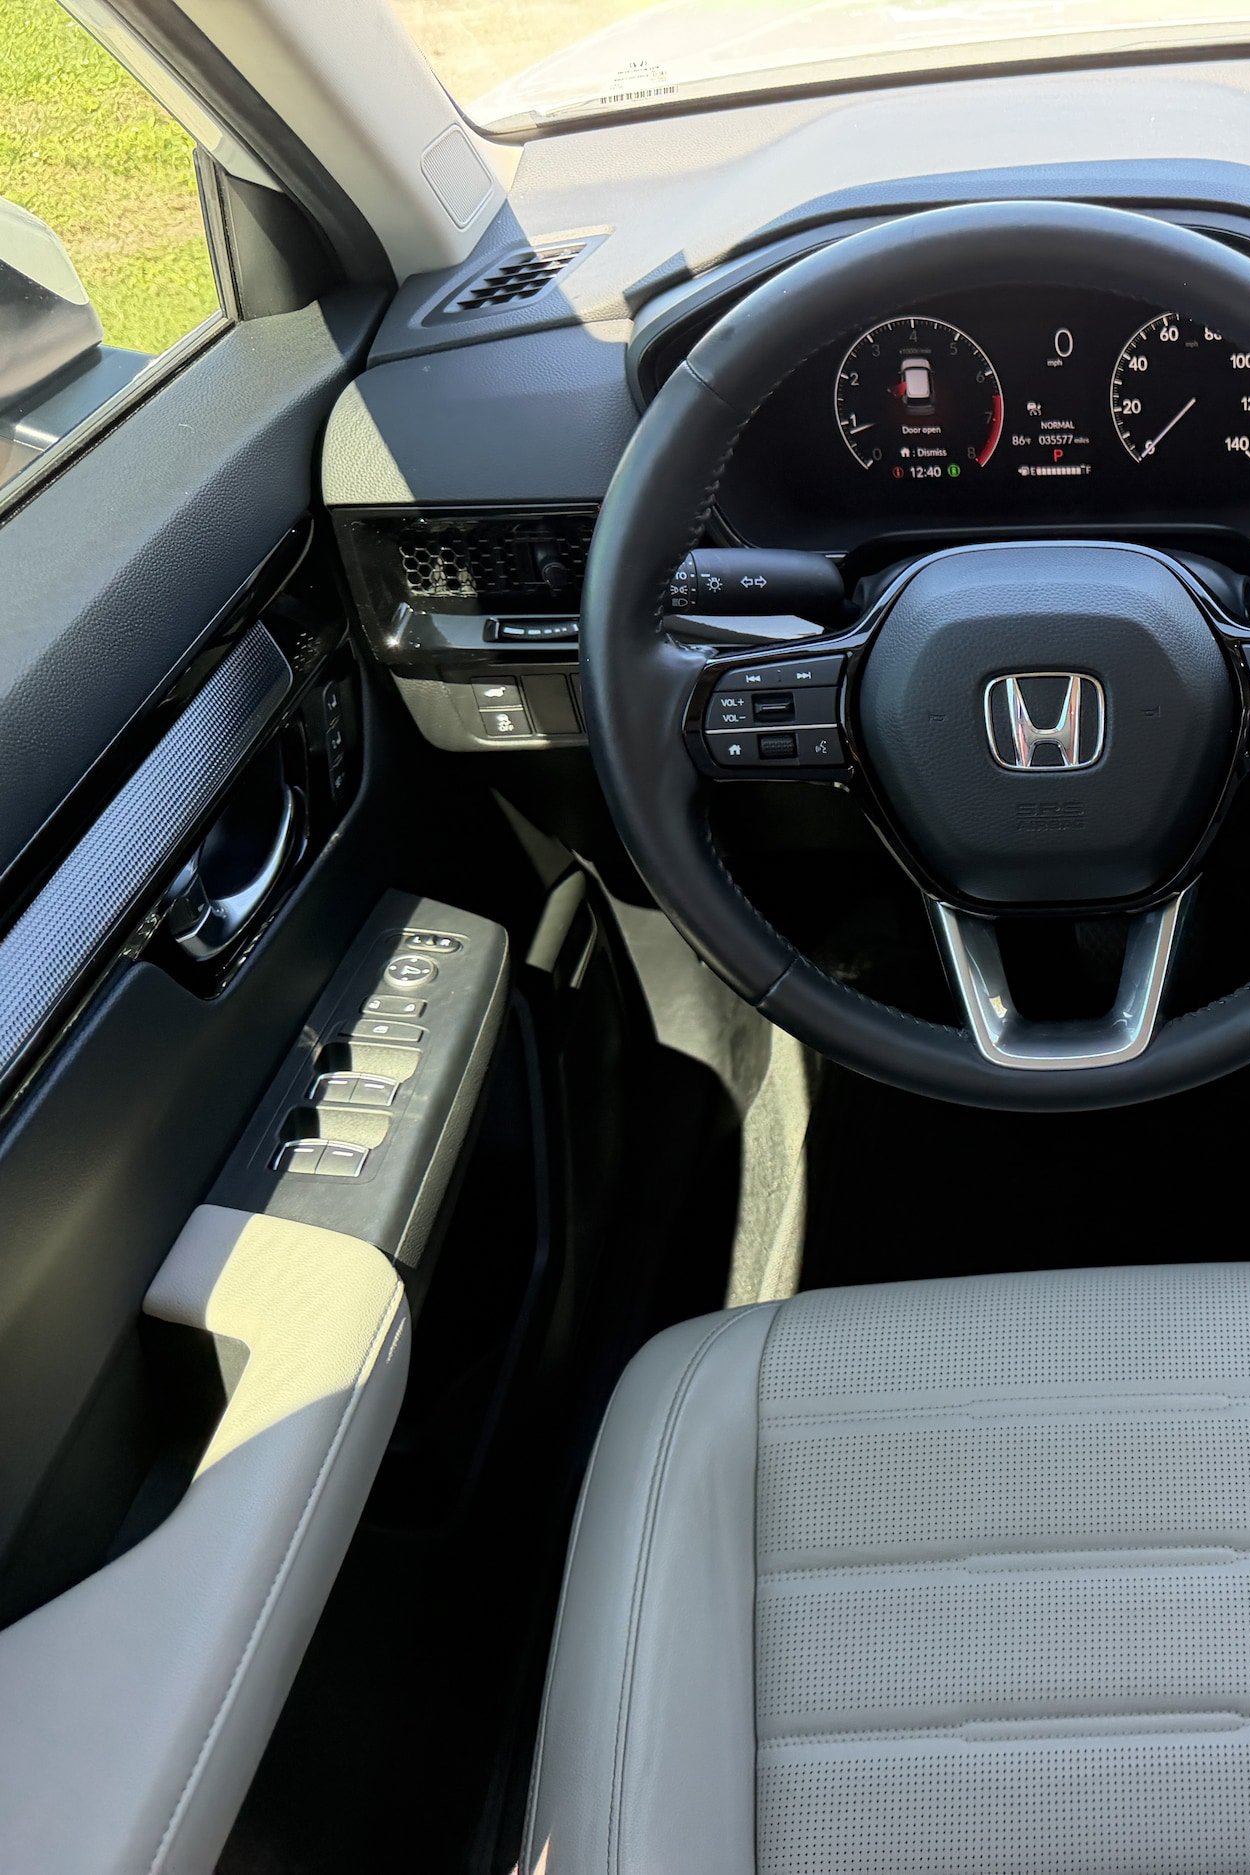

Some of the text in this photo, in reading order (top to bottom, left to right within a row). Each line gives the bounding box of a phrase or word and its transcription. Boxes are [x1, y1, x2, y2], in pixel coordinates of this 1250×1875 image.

[909, 331, 918, 342] 4
[1159, 326, 1179, 342] 60
[950, 343, 958, 355] 5
[1054, 329, 1074, 358] 0
[871, 345, 881, 357] 3
[1047, 359, 1063, 367] mph
[1128, 356, 1148, 372] 40
[850, 373, 859, 386] 2
[976, 374, 985, 383] 6
[1122, 400, 1142, 414] 20
[850, 414, 857, 427] 1
[985, 412, 993, 424] 7
[902, 426, 942, 436] Door open
[1040, 421, 1075, 430] NORMAL
[1038, 435, 1074, 445] 035577
[1225, 436, 1250, 451] 140
[872, 448, 882, 461] 0
[917, 448, 947, 457] Dismiss
[967, 447, 976, 460] 8
[1053, 449, 1063, 462] P
[910, 466, 942, 478] 12:40
